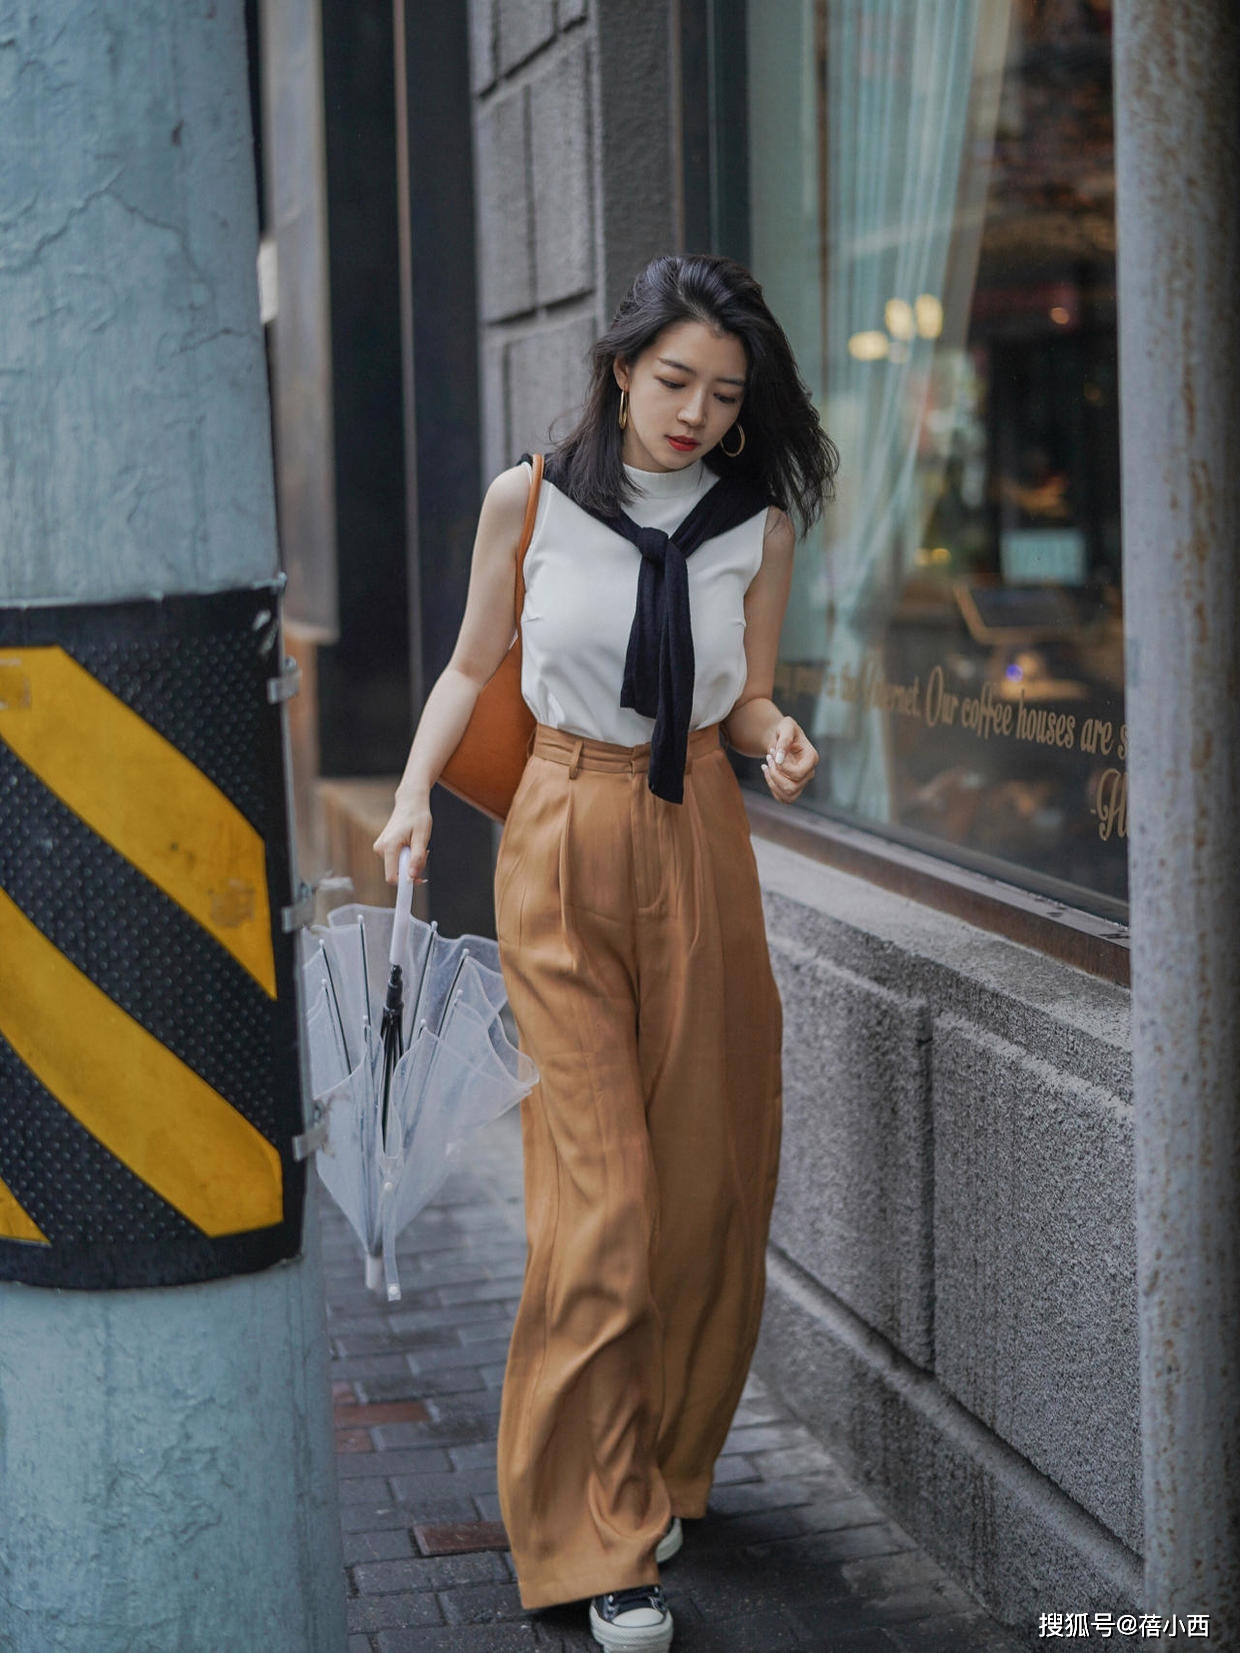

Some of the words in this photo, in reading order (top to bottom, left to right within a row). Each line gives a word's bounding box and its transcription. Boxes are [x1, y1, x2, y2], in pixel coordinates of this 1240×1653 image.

[926, 665, 959, 727] Our
[961, 684, 1013, 740] coffee
[1015, 689, 1076, 749] houses
[1080, 717, 1114, 756] are
